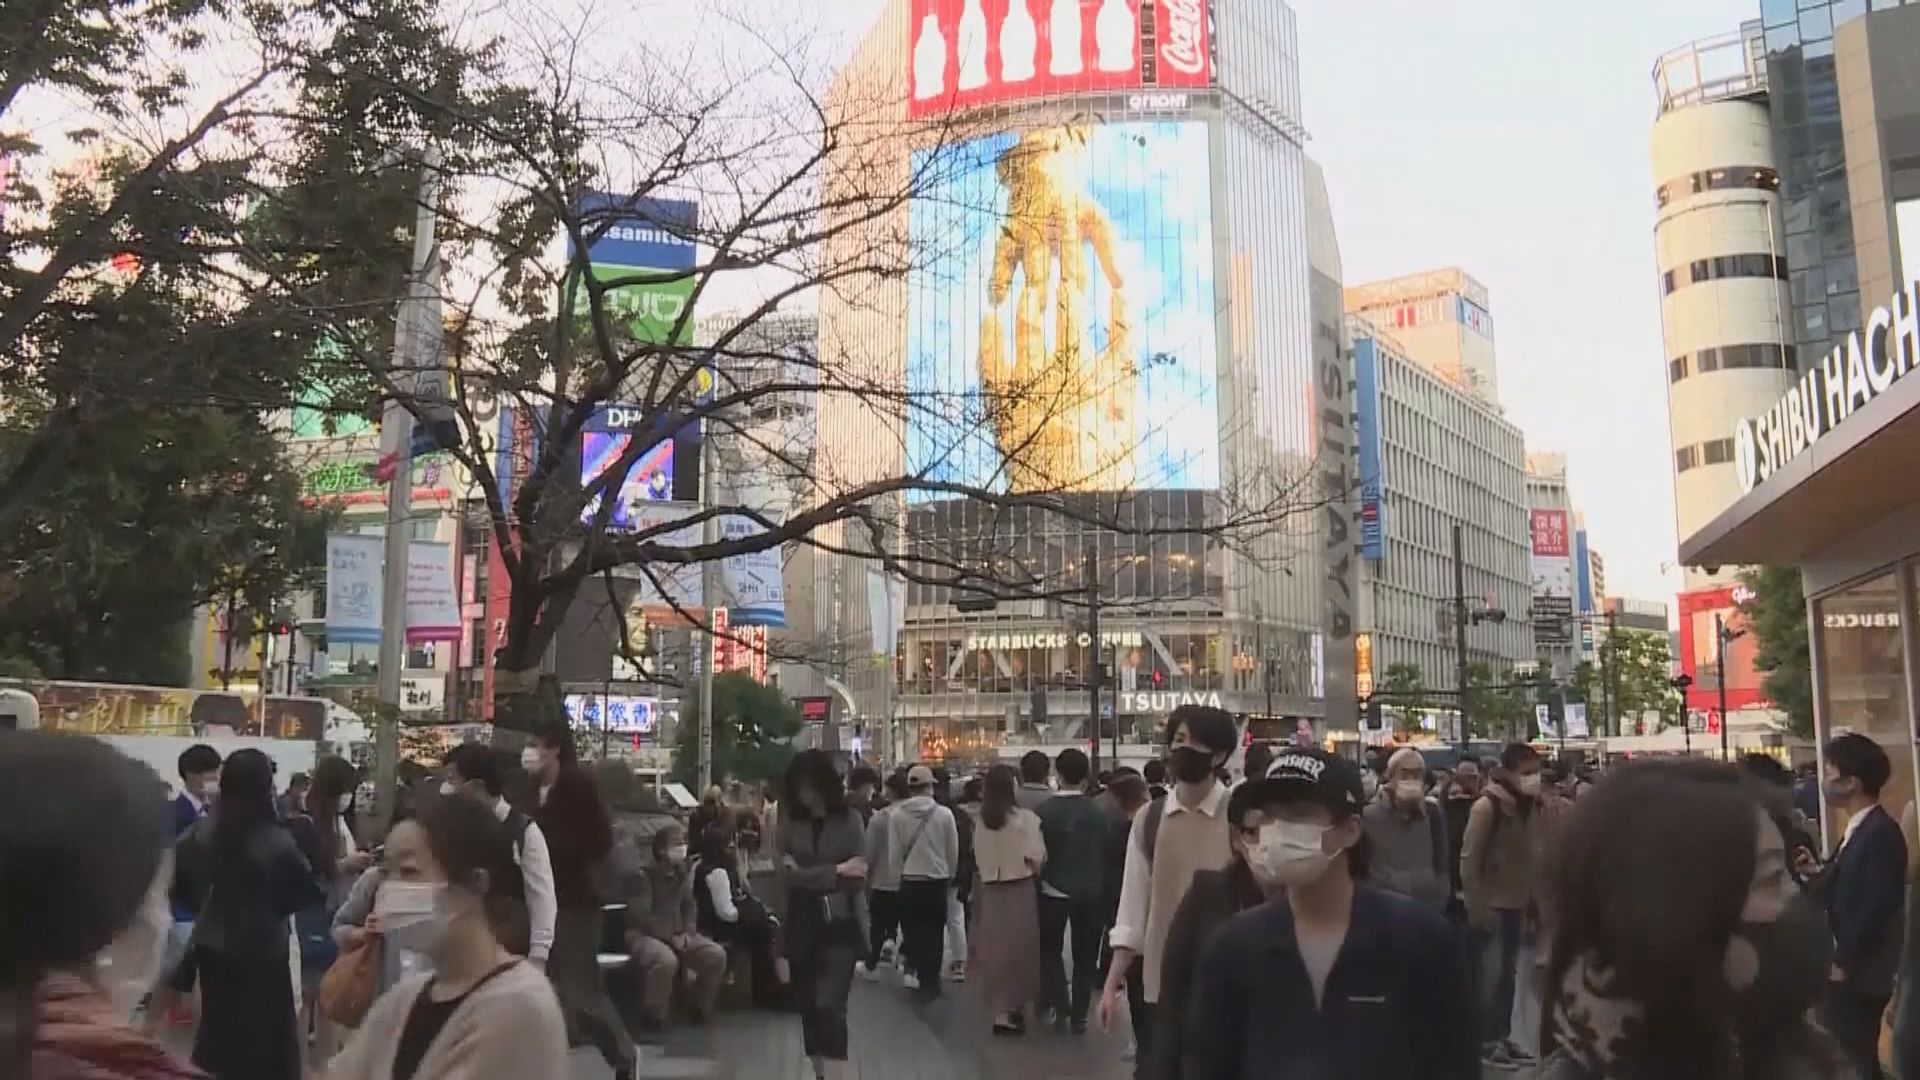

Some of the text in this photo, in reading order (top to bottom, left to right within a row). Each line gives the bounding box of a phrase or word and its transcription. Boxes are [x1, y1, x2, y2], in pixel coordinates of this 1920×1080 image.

[607, 408, 643, 428] DH
[1757, 367, 1820, 481] SHIBU
[1319, 320, 1351, 640] TSUTAYA
[968, 631, 1142, 650] STARBUCKS CFFEE
[1121, 692, 1222, 712] TSUTAYA
